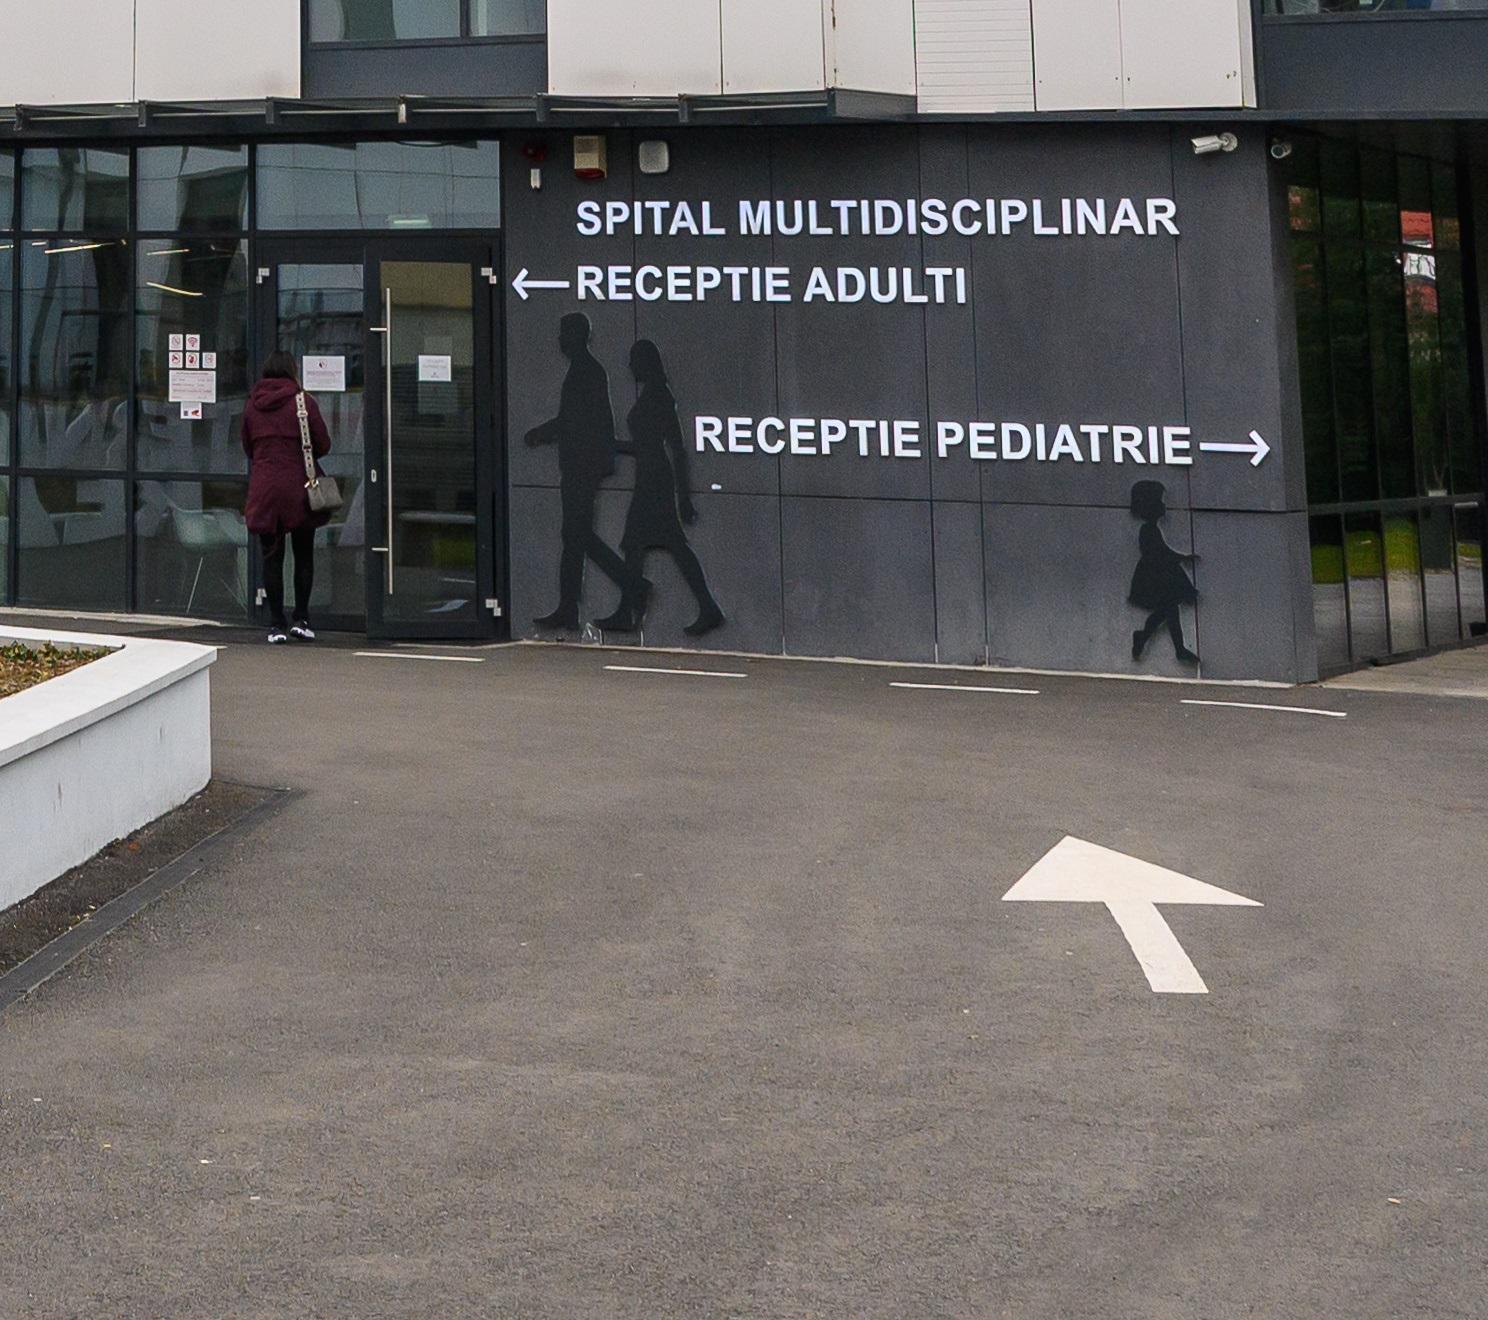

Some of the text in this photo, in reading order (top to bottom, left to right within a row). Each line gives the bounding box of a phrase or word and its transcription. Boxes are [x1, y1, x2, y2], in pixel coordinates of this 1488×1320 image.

[576, 197, 1181, 236] SPITAL MULTIDISCIPLINAR
[576, 265, 967, 304] RECEPTIE ADULTI
[695, 415, 1193, 465] RECEPTIE PEDIATRIE
